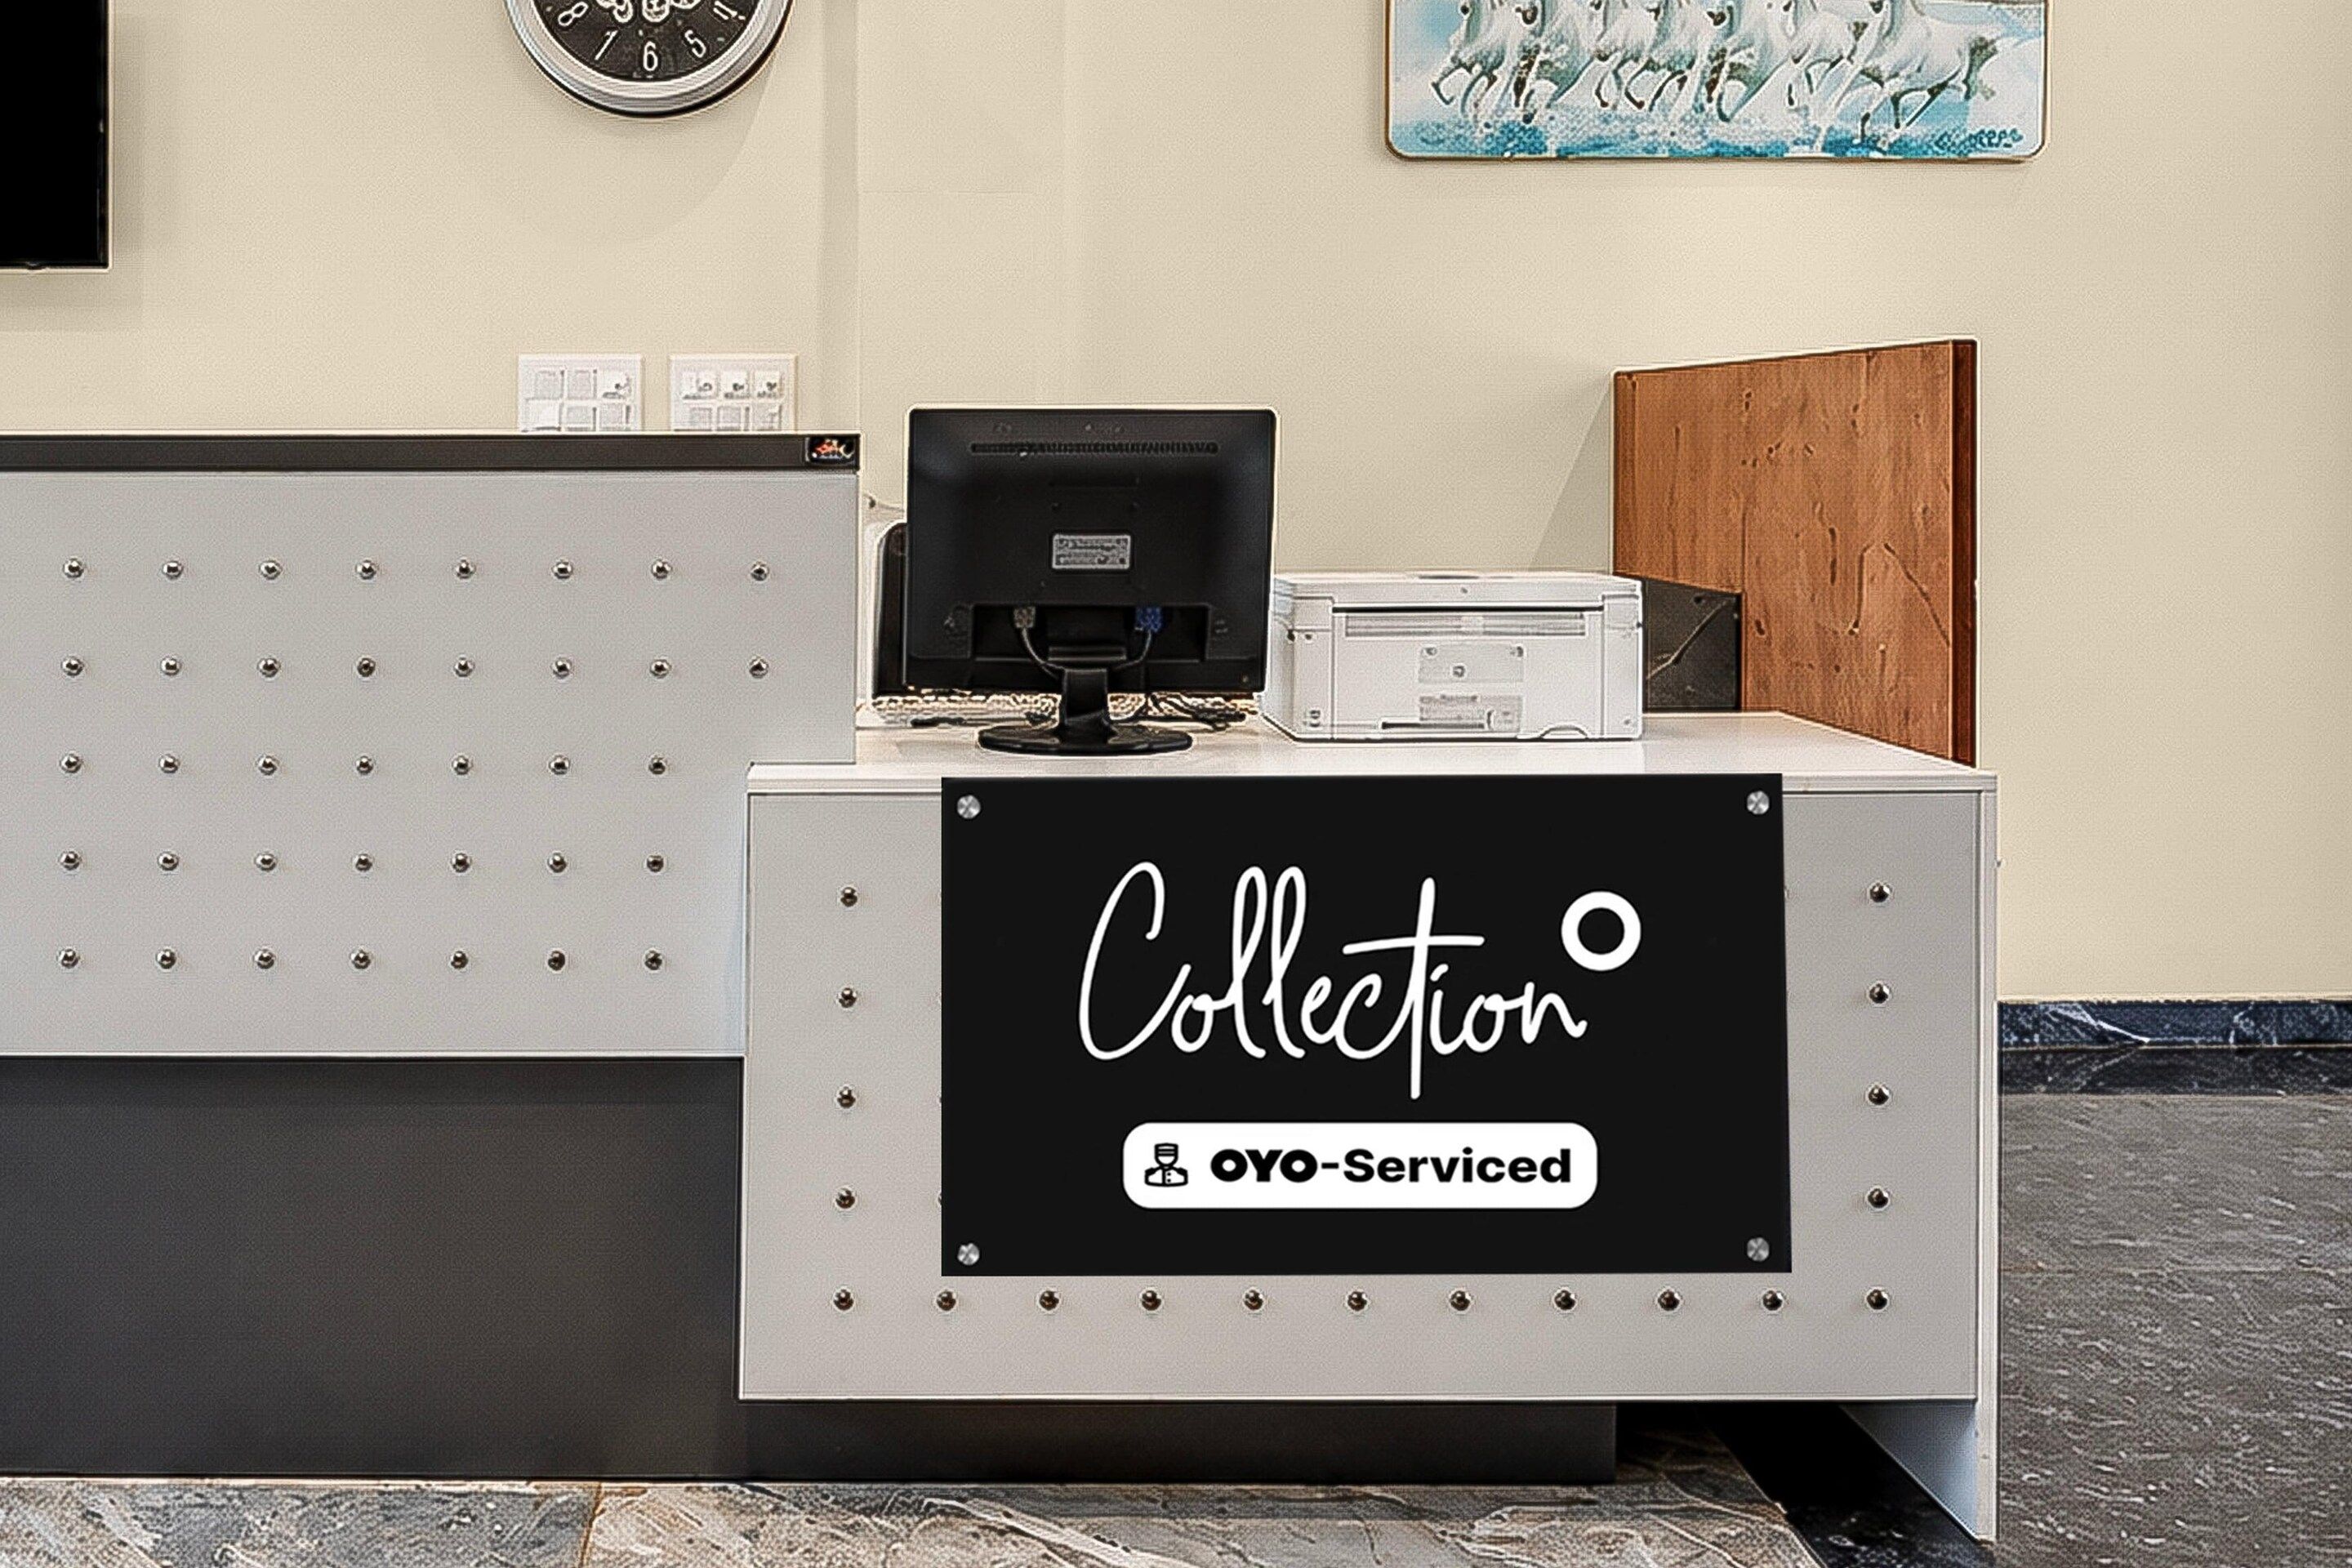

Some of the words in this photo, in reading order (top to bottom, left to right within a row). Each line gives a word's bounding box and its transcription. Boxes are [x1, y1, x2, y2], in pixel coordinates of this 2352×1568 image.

[558, 1, 589, 27] 8
[643, 40, 658, 72] 6
[684, 29, 707, 59] 5
[1080, 862, 1587, 1099] Collection
[1210, 1147, 1571, 1183] OYO-Serviced
